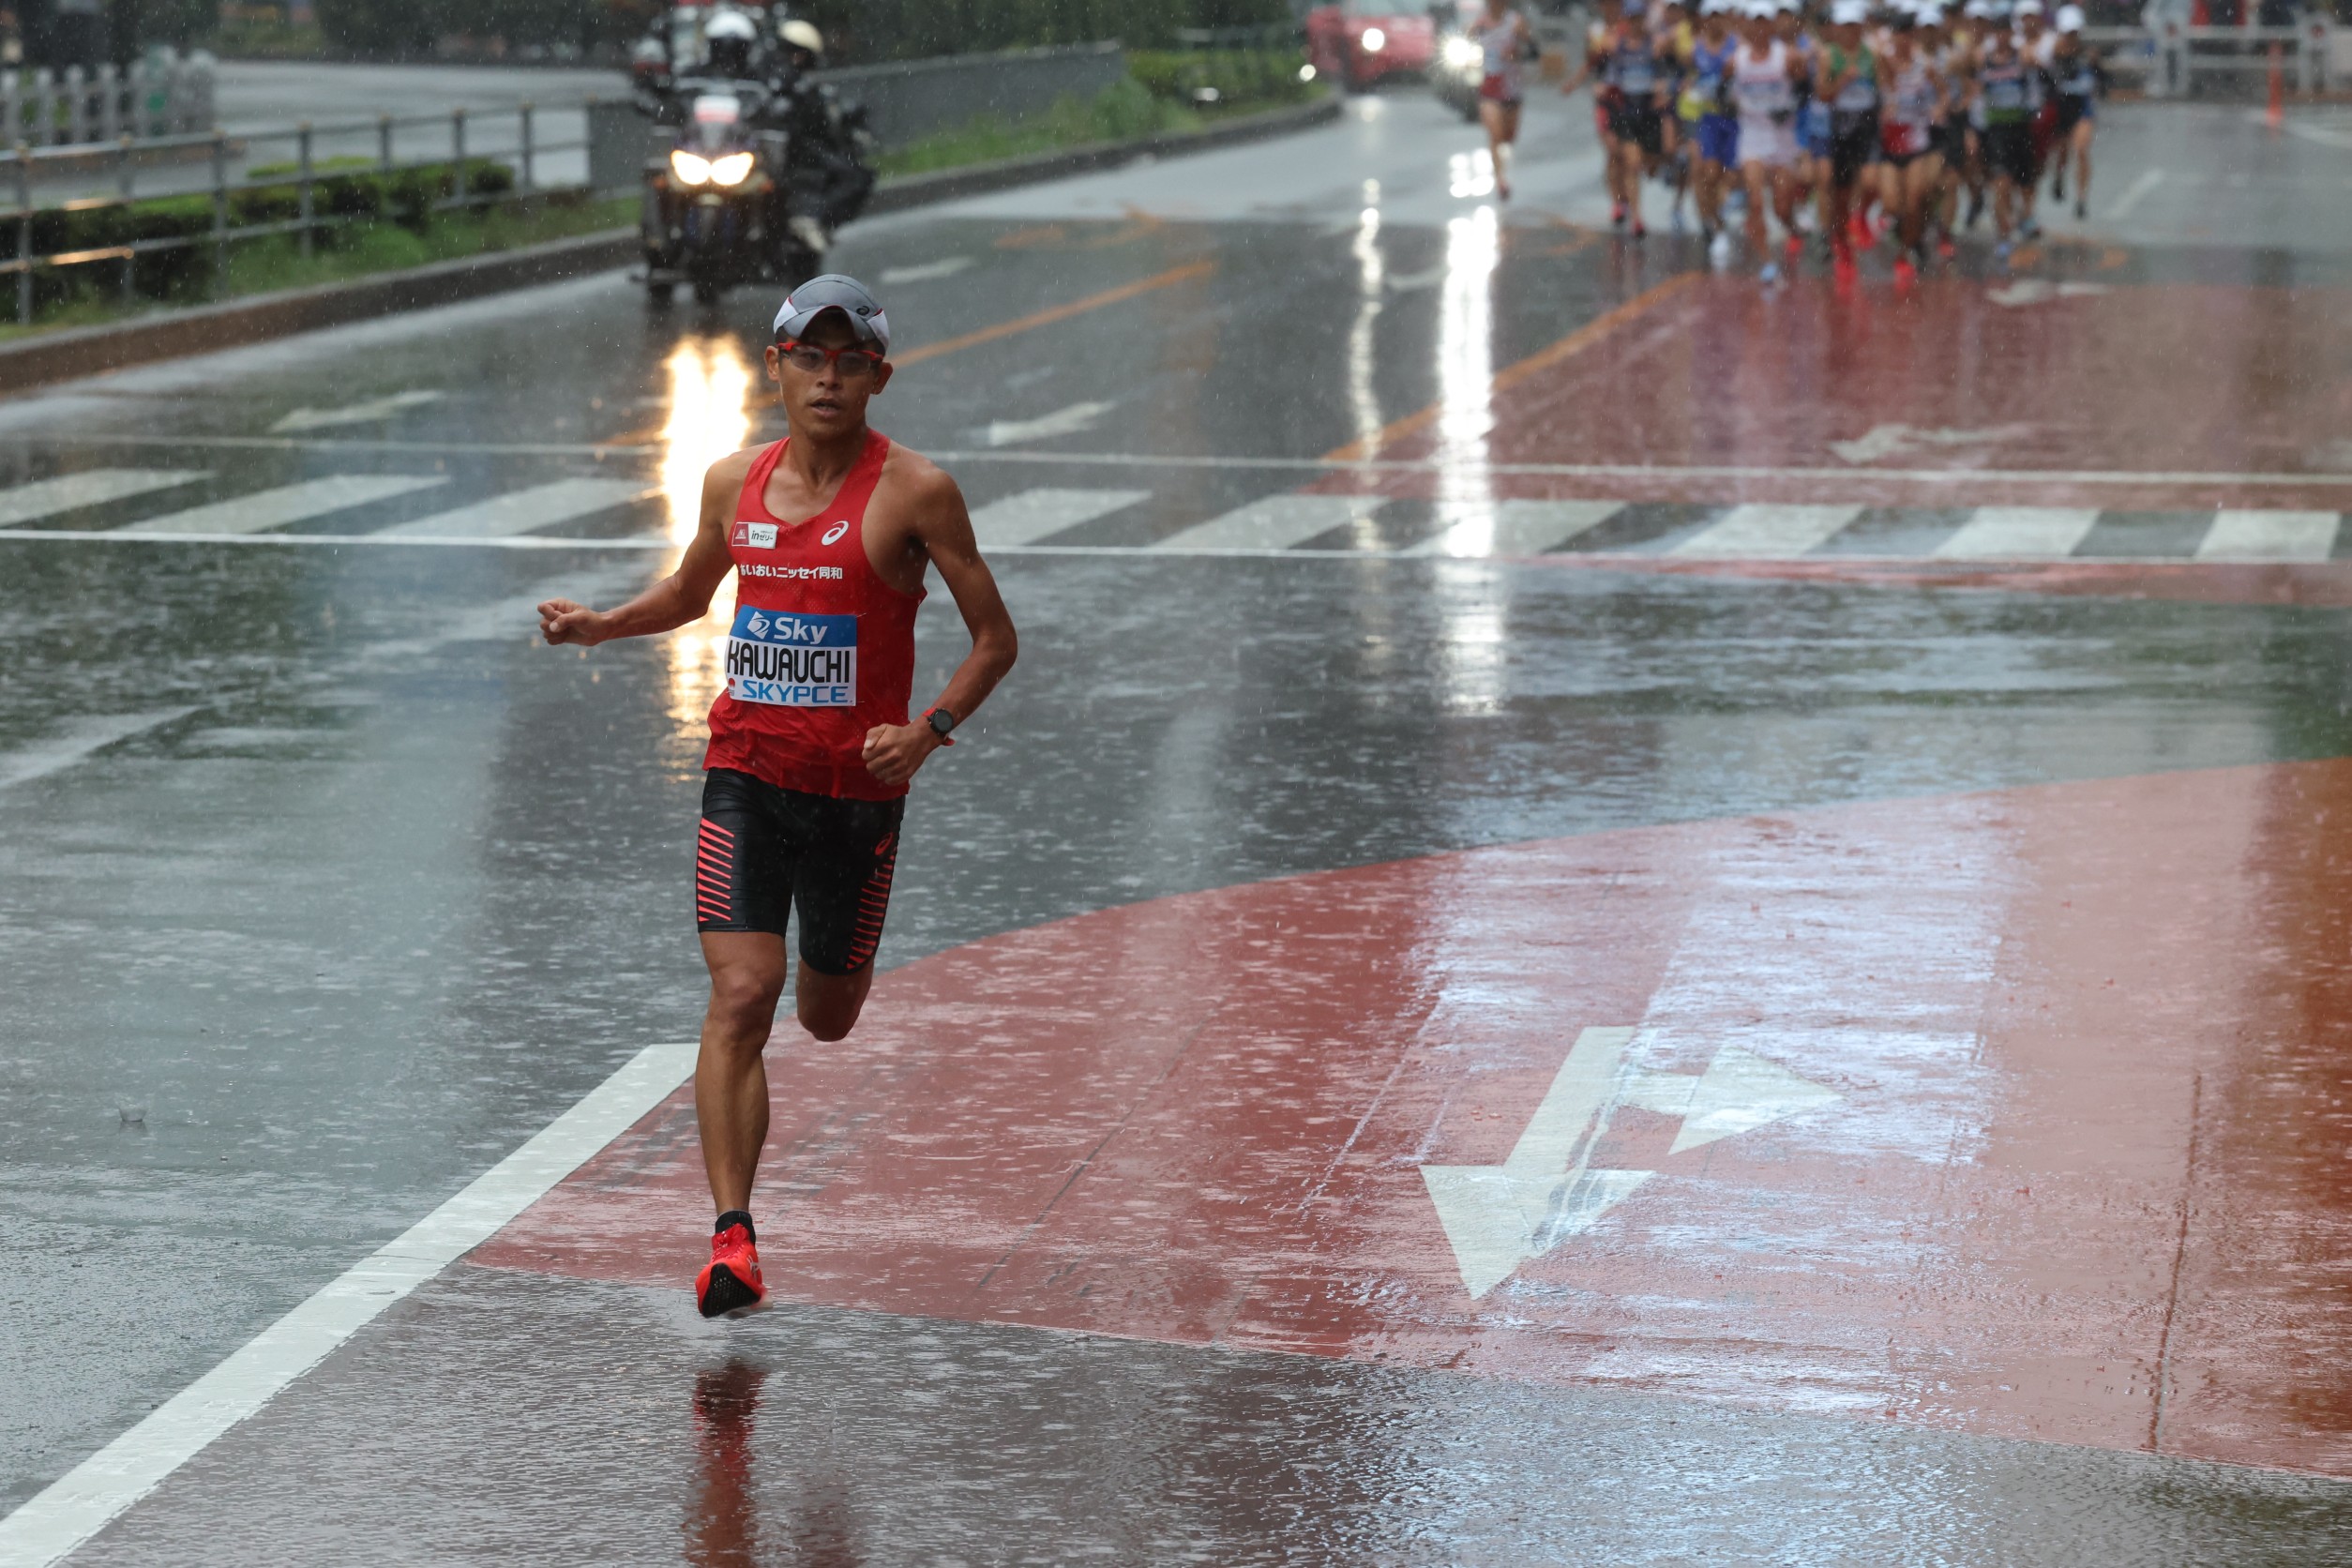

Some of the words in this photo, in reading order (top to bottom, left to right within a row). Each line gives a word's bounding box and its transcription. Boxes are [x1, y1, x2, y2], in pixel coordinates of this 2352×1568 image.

[774, 616, 828, 645] Sky
[727, 640, 850, 684] KAWAUCHI
[742, 679, 849, 703] SKYPCE
